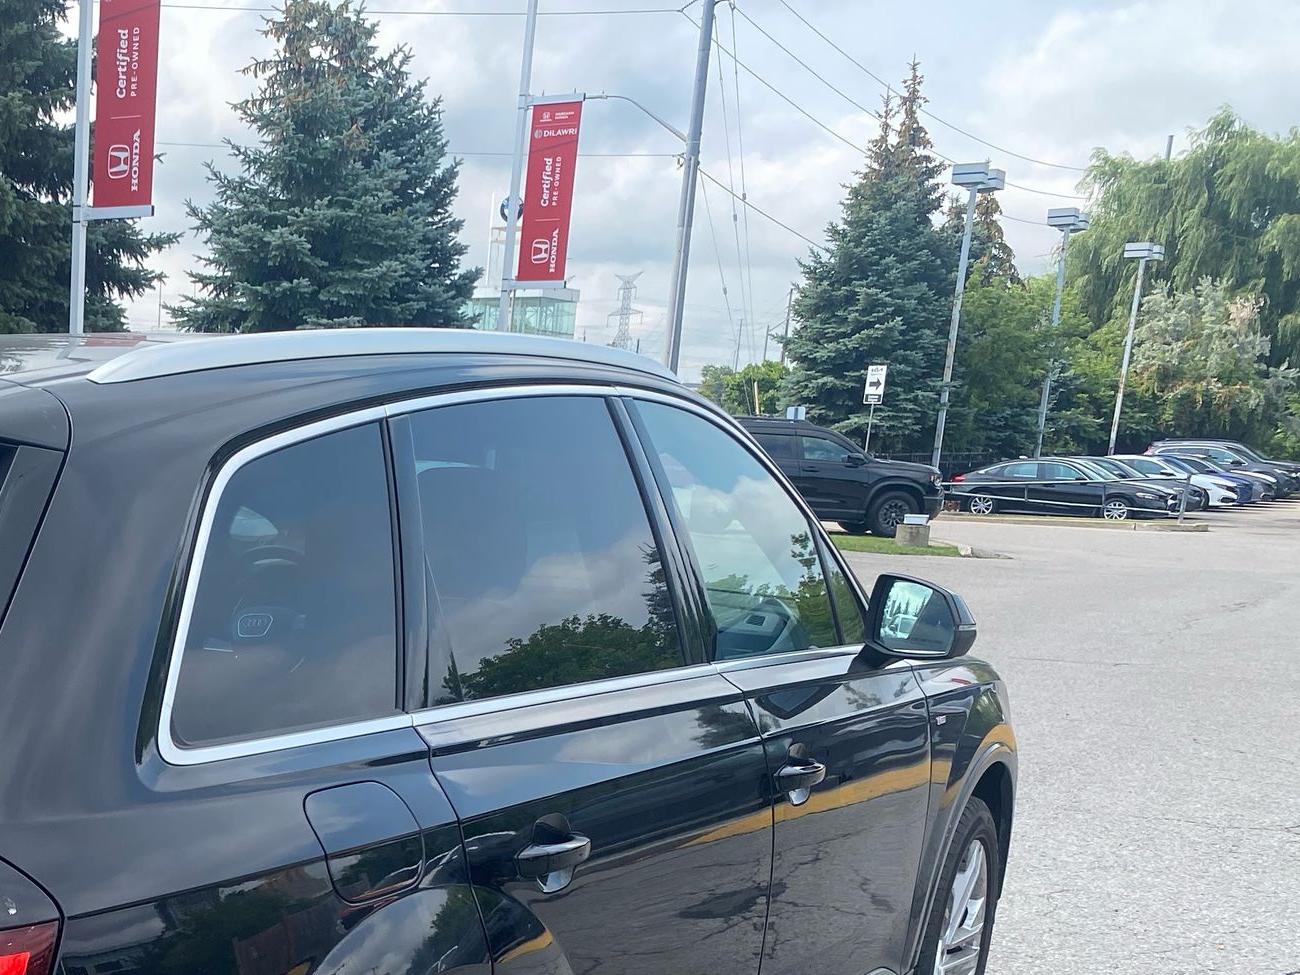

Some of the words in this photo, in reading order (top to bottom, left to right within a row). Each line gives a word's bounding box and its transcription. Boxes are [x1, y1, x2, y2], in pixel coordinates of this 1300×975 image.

[116, 29, 129, 99] Certified
[130, 27, 140, 97] PRE-OWNED
[543, 128, 577, 137] DILAWRI
[131, 128, 141, 192] HONDA
[540, 157, 553, 207] Certified
[552, 156, 562, 206] PRE-OWNED
[549, 228, 559, 273] HONDA
